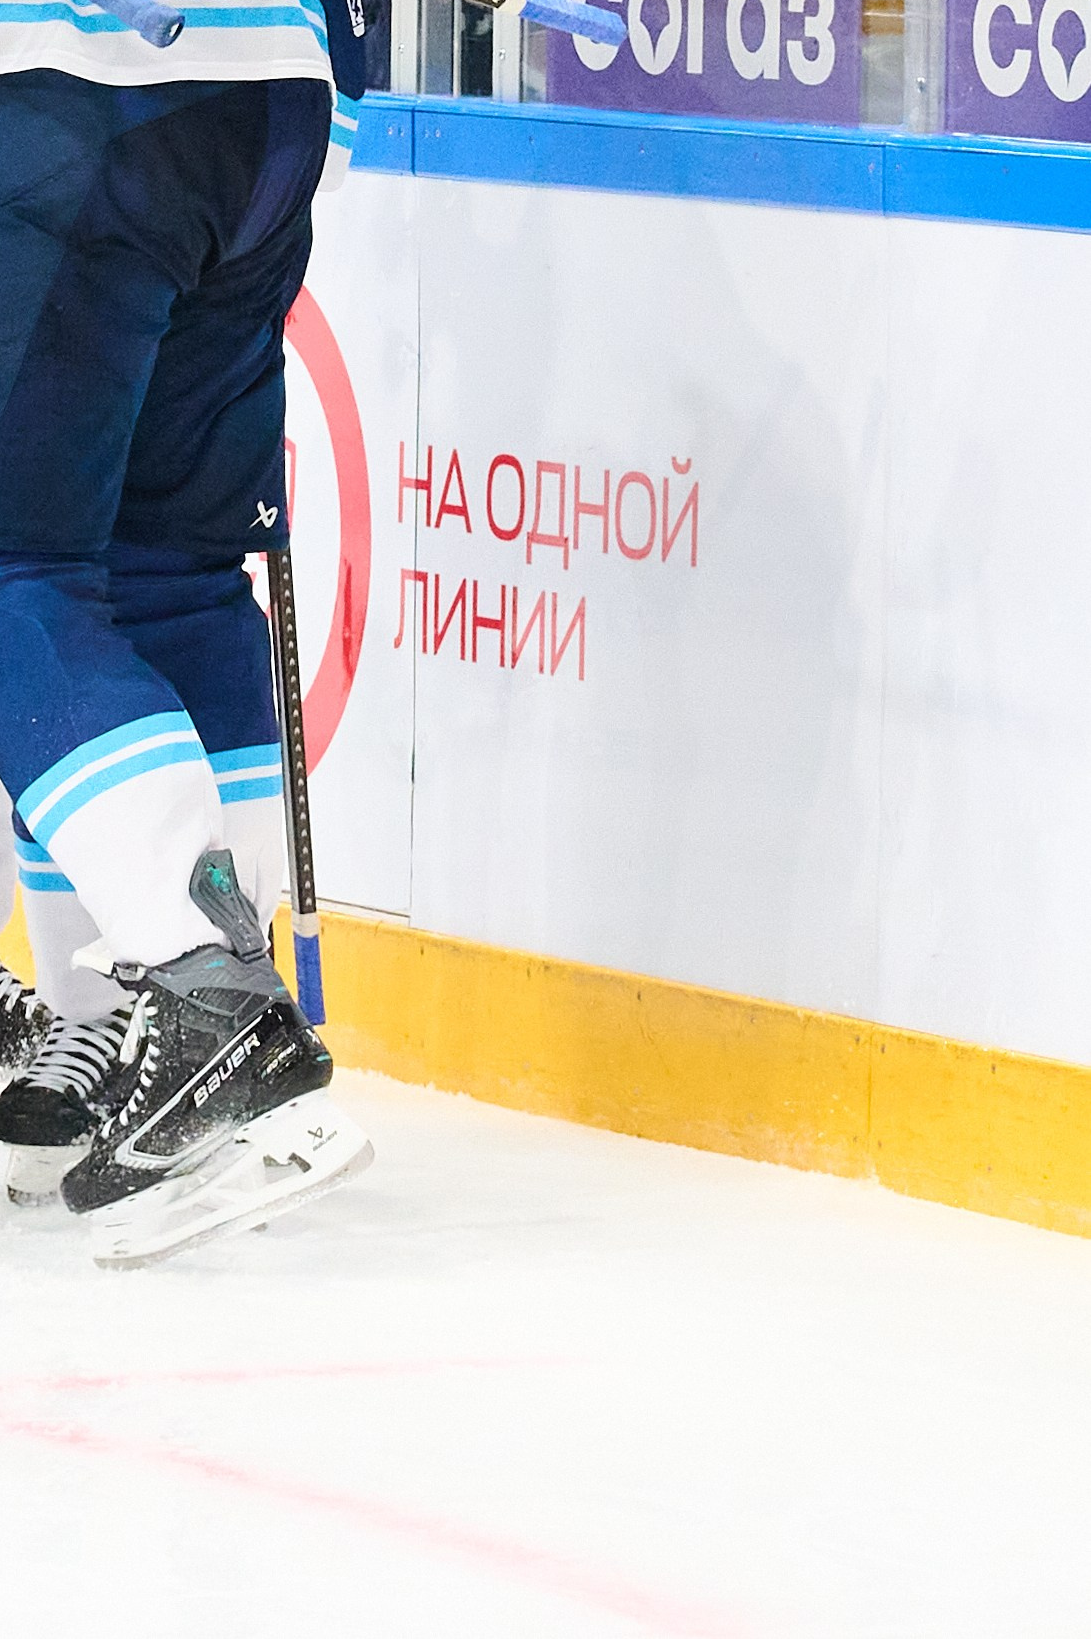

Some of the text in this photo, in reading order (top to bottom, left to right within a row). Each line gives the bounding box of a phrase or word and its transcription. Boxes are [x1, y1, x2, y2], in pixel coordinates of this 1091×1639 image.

[398, 441, 700, 571] НА ОДНОЙ
[394, 568, 586, 681] ЛИНИИ
[193, 1032, 261, 1109] BAUER
